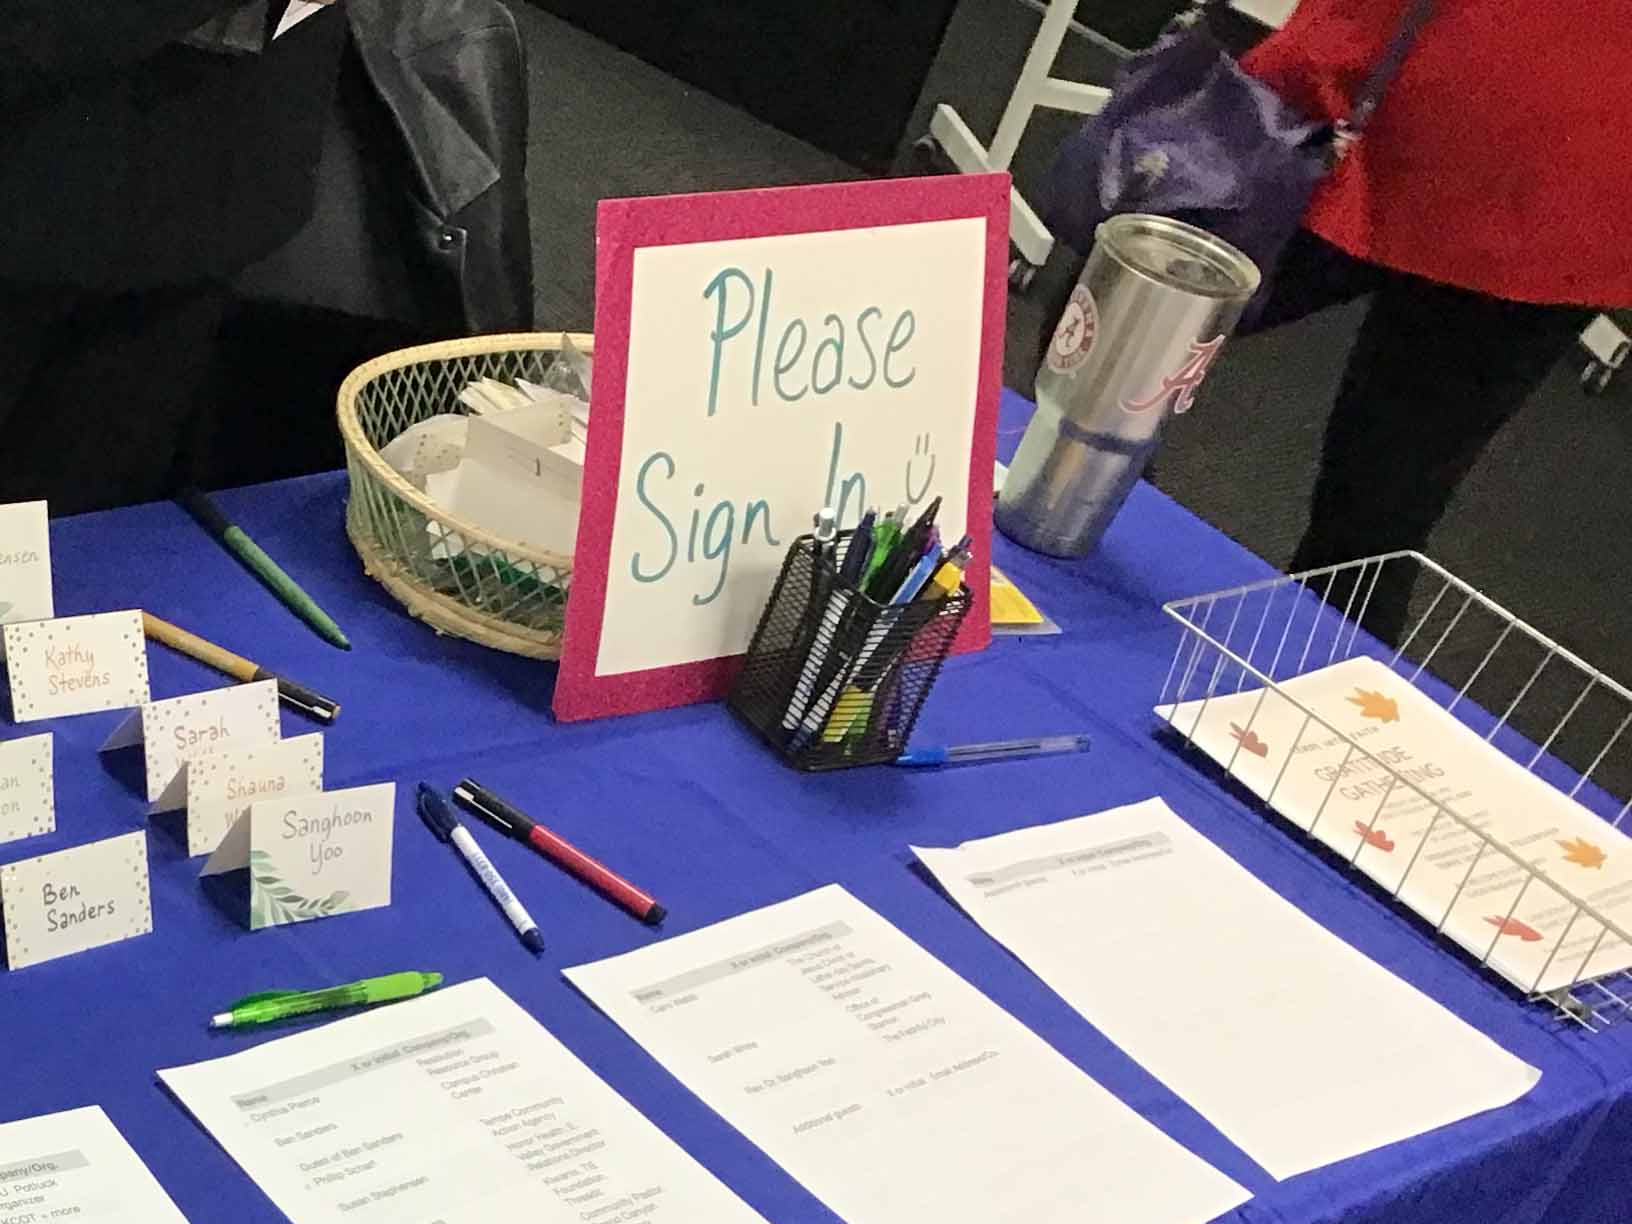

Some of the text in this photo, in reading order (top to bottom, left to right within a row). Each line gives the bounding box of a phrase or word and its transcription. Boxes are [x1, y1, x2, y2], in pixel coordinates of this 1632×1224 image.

[703, 267, 916, 415] Please
[632, 423, 865, 605] Sign In
[44, 645, 96, 674] Kathy
[48, 668, 112, 694] Stevens
[174, 722, 231, 751] Sarah
[227, 775, 287, 801] Shauna
[282, 809, 374, 841] Sanghoon
[308, 842, 344, 877] Yoo
[42, 881, 81, 908] Ben
[47, 896, 116, 934] Sanders
